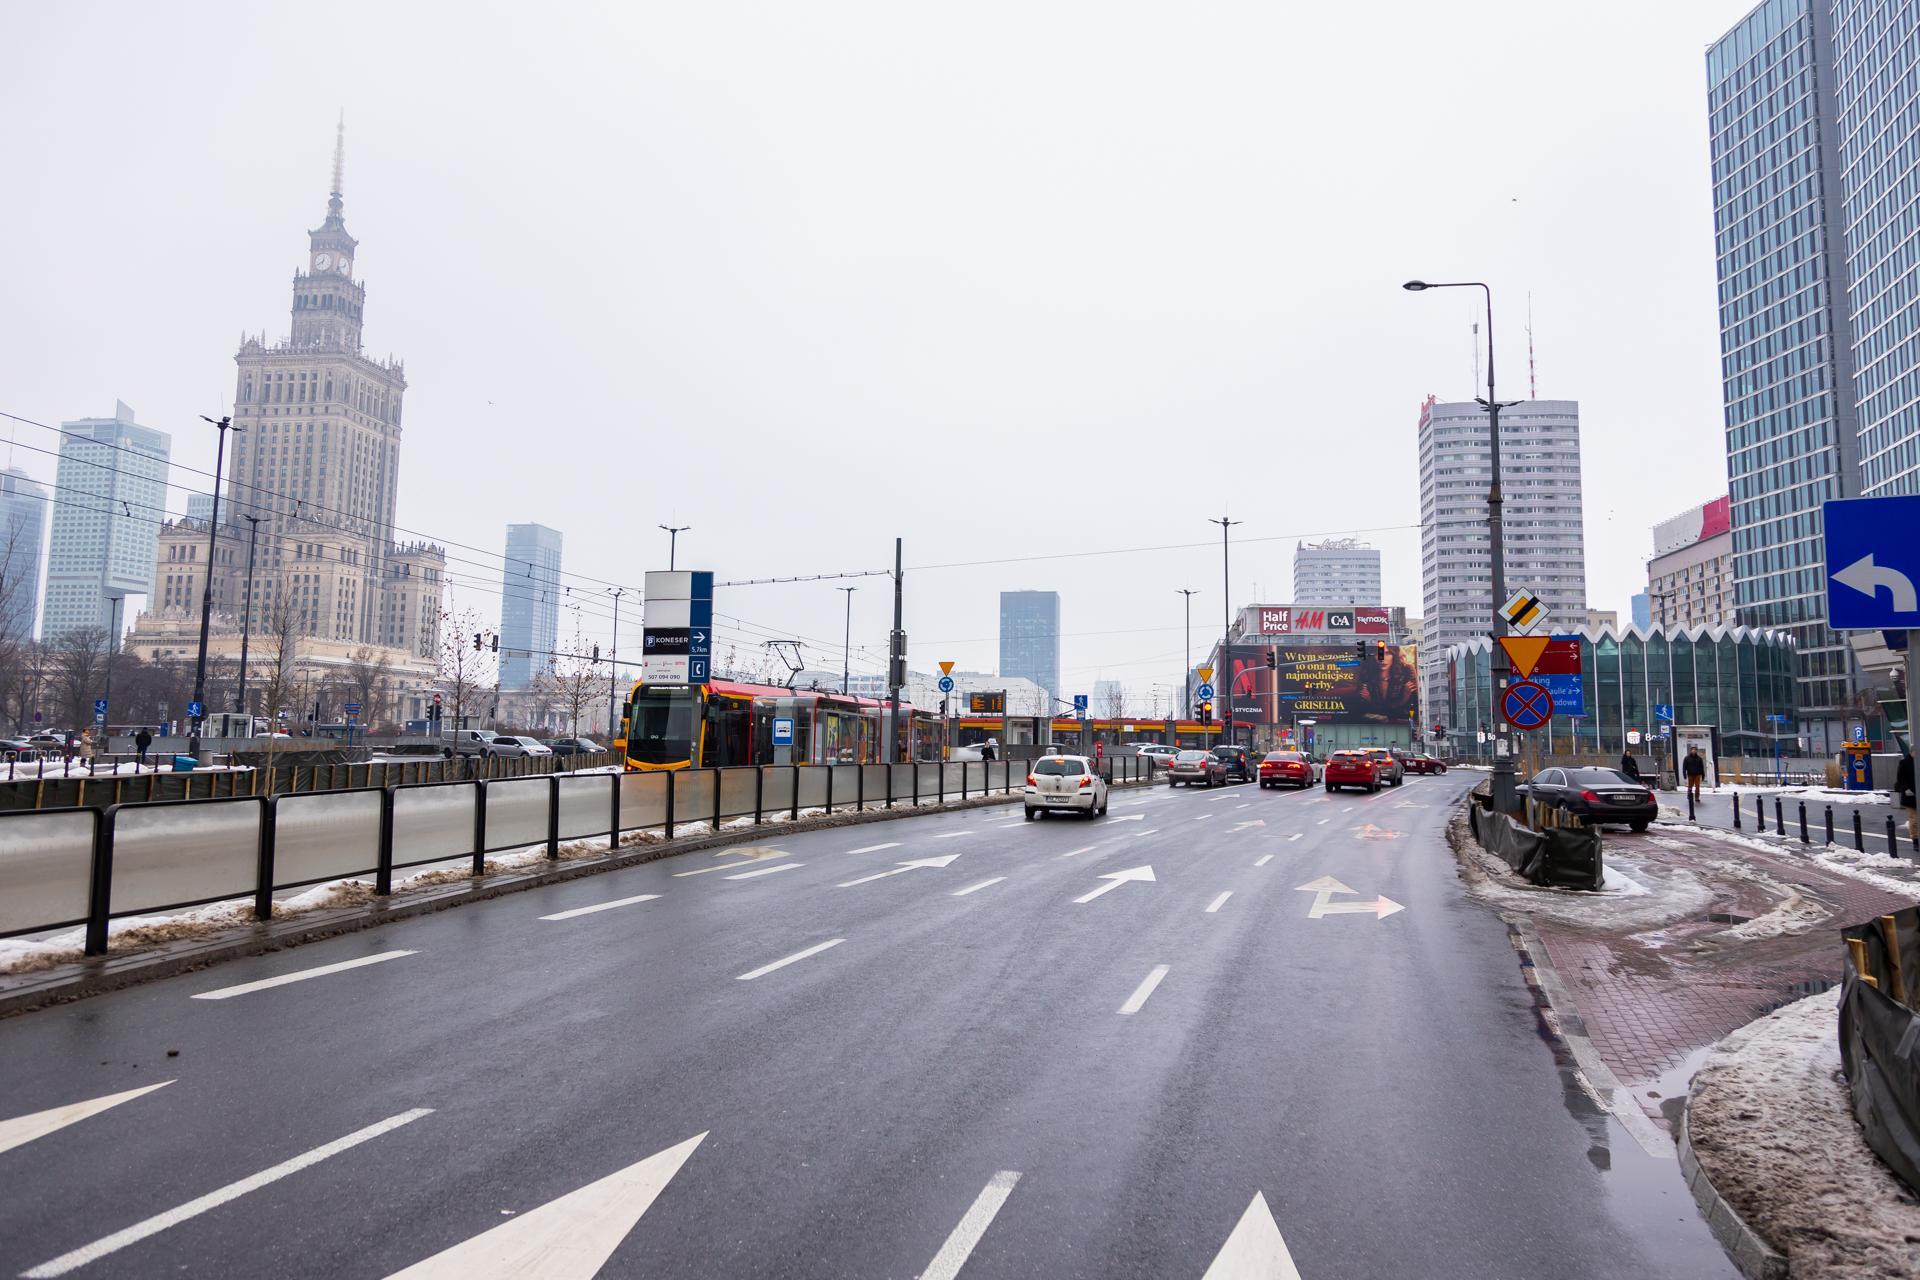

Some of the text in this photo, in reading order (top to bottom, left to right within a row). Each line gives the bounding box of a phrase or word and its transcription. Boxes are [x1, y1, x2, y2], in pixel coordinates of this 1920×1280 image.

[1263, 610, 1288, 622] Half
[1296, 610, 1324, 630] H&M
[1263, 622, 1288, 630] Price
[1285, 652, 1296, 660] W
[1298, 653, 1316, 662] tym
[1286, 671, 1354, 682] najmodniejsze
[1295, 701, 1344, 710] GRISELDA
